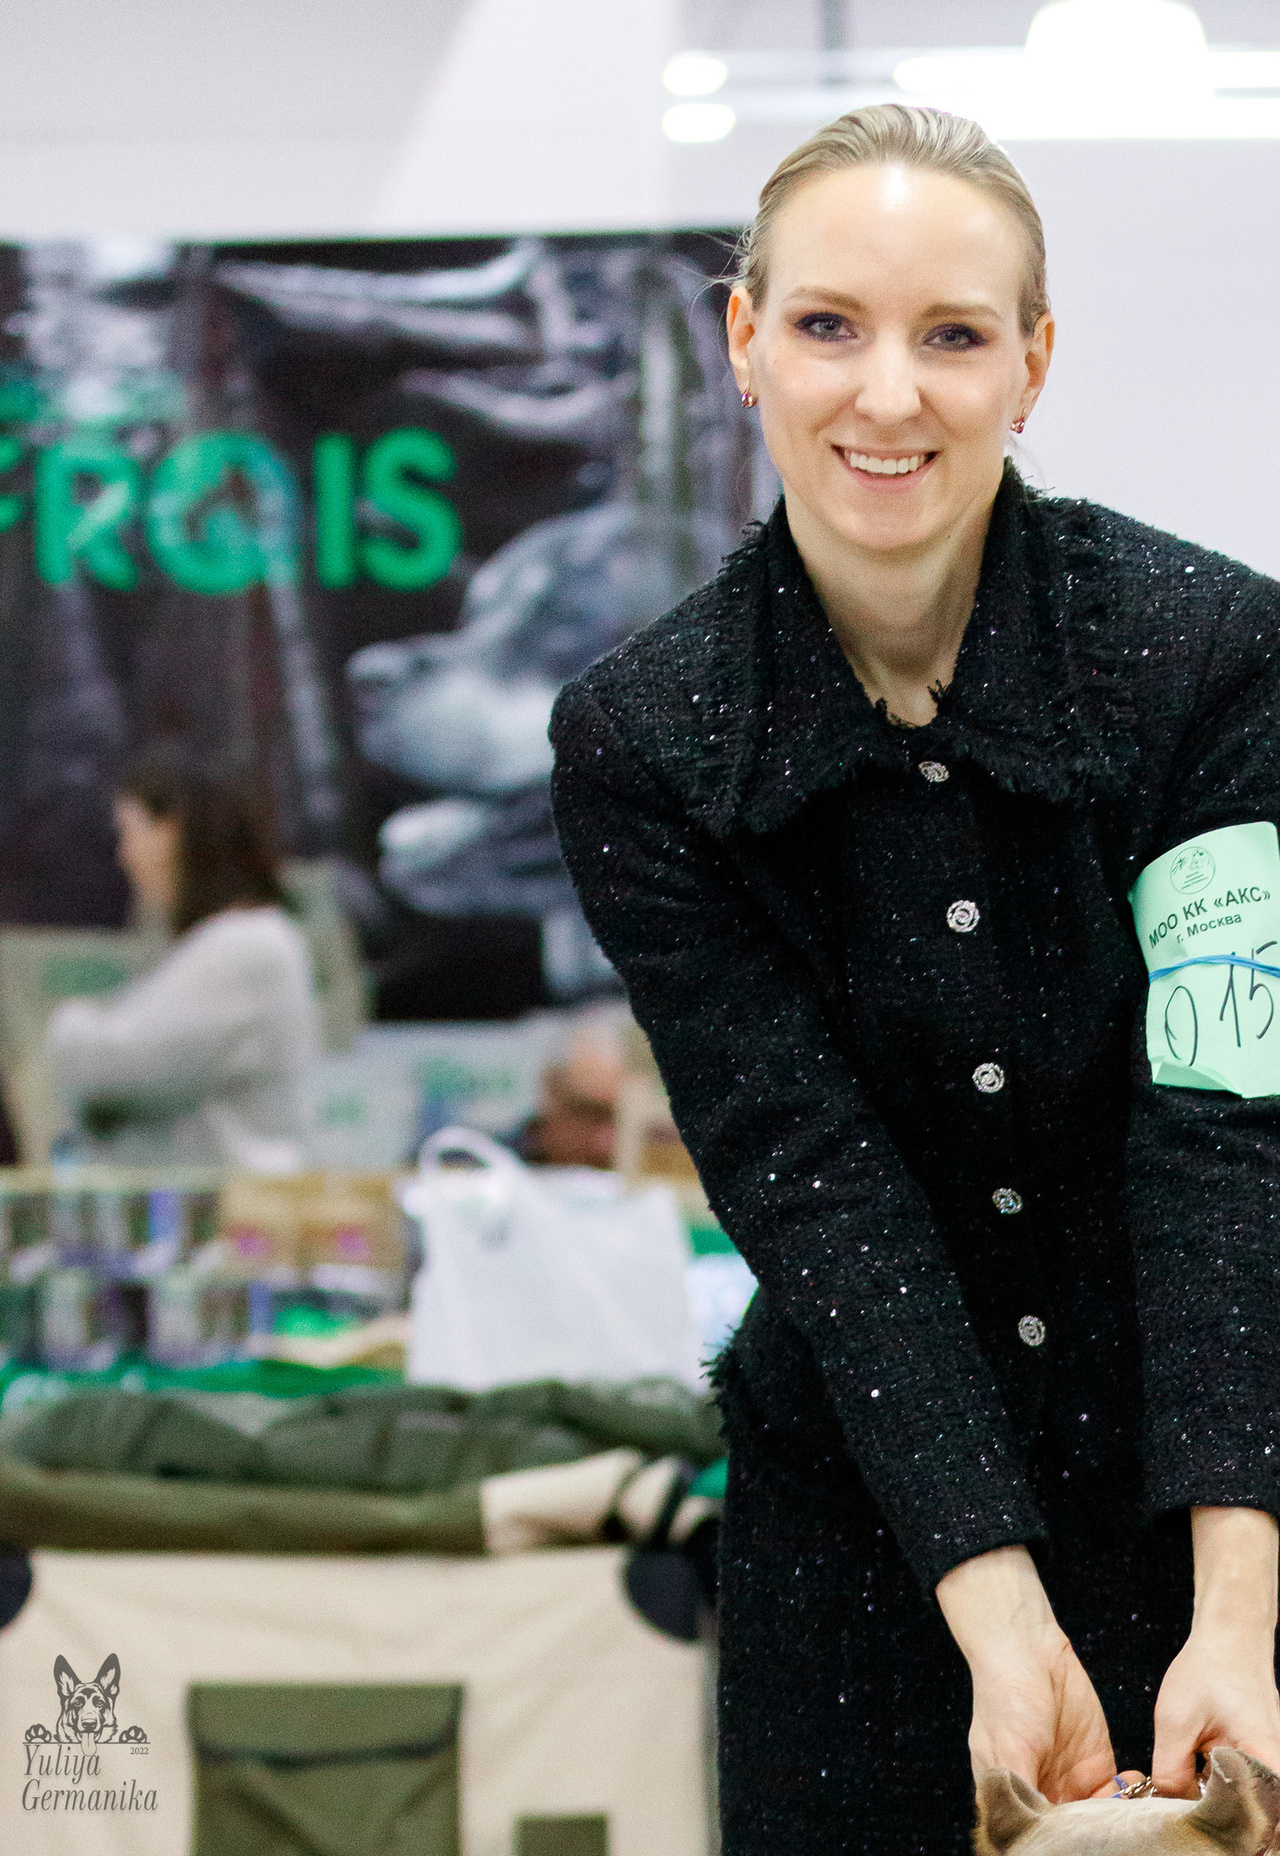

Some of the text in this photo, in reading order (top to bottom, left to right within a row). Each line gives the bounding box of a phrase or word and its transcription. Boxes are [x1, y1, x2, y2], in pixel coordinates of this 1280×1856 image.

[0, 424, 463, 596] ROIS
[1148, 886, 1271, 949] МОО КК «АКС»
[1186, 913, 1242, 937] Москва
